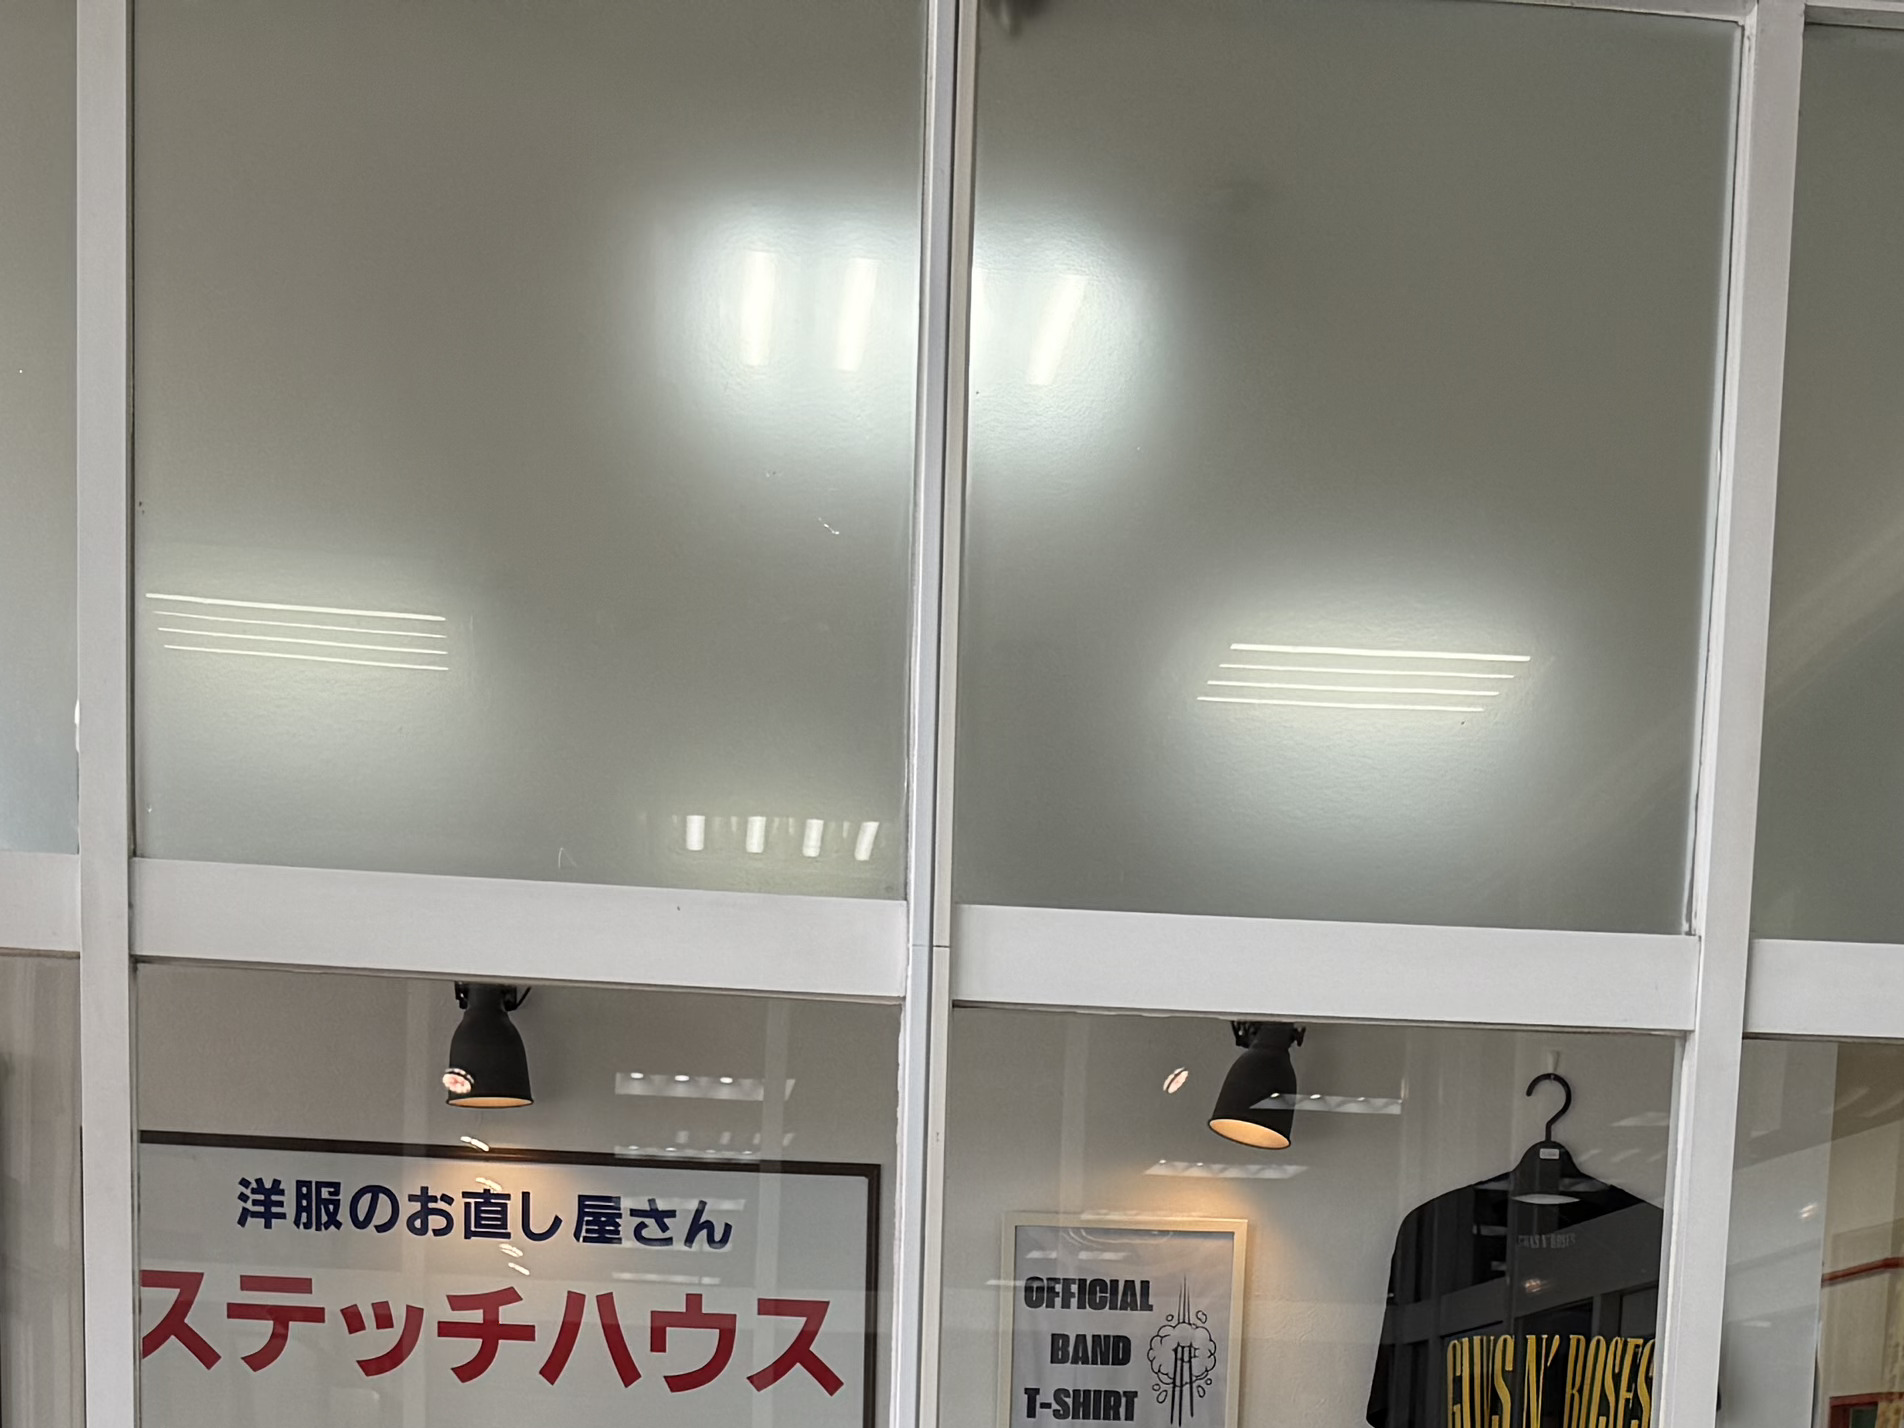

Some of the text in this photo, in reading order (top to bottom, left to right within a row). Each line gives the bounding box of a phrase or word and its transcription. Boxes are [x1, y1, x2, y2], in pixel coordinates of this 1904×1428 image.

[237, 1177, 734, 1250] 洋服のお直し屋さん
[1023, 1276, 1154, 1313] OFFICIAL
[141, 1269, 844, 1397] ステッチハウス
[1049, 1333, 1132, 1367] BAND
[1023, 1387, 1139, 1422] T-SHIRT
